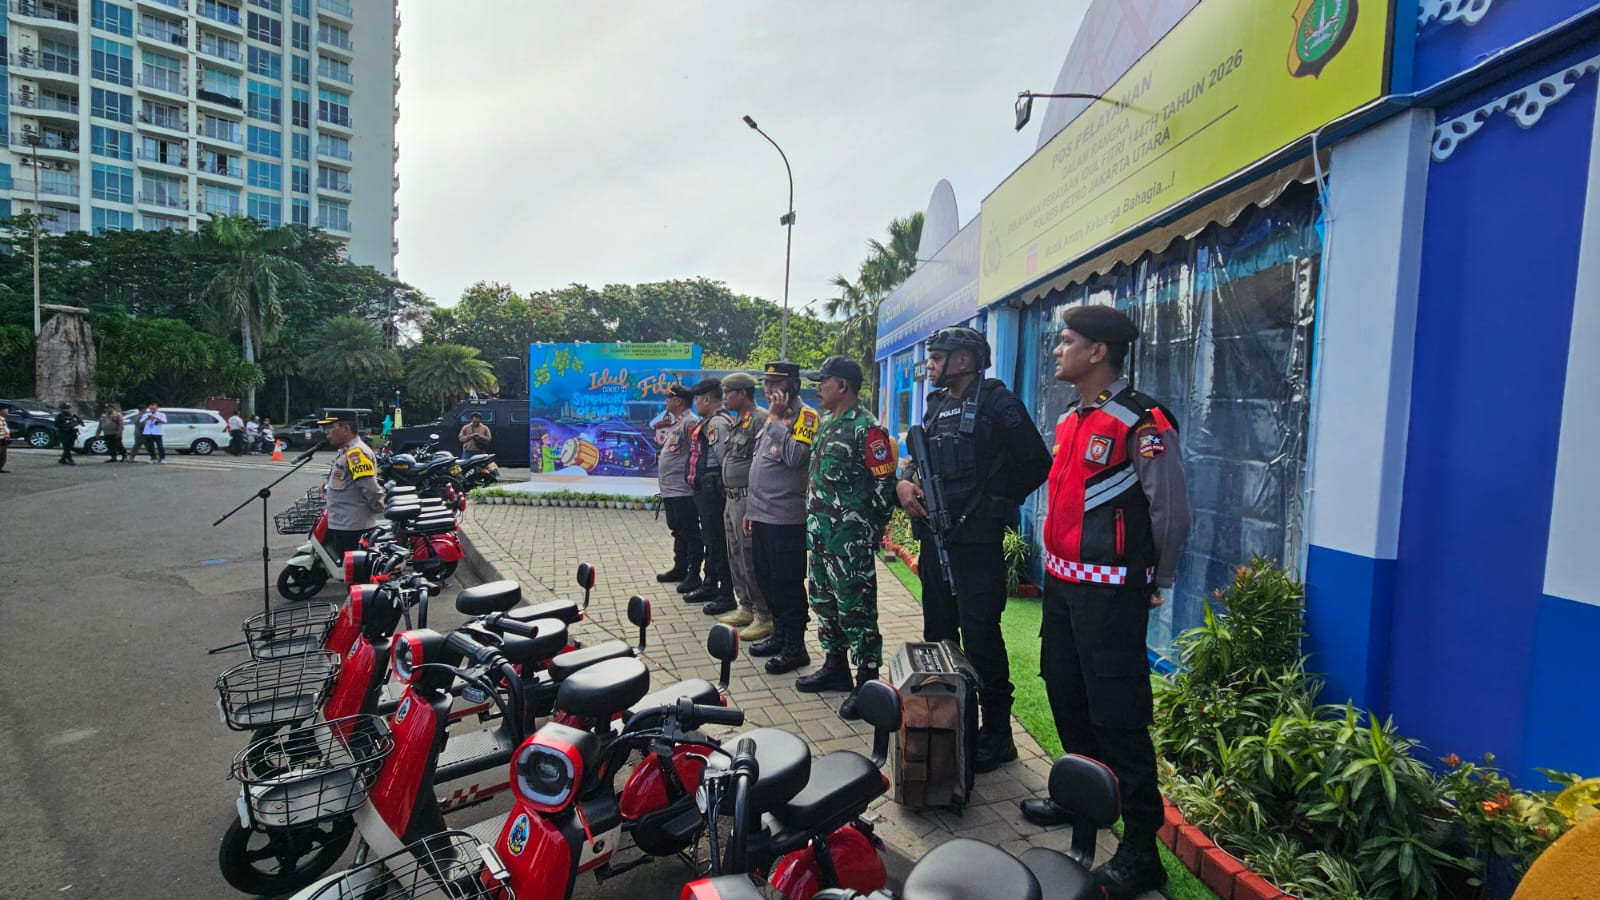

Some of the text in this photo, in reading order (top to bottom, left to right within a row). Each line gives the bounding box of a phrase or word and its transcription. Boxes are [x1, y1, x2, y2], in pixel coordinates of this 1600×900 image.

[1052, 71, 1152, 169] POS PELAYANAN
[1078, 162, 1100, 186] IDUL
[1101, 141, 1125, 168] FITRI
[1161, 75, 1206, 122] TAHUN
[1208, 47, 1244, 89] 2026
[1063, 116, 1130, 179] DALAM RANGKA
[1032, 125, 1171, 232] POLRES METRO JAKARTA UTARA
[573, 391, 627, 406] SYMPHONY
[588, 367, 629, 391] Idul
[576, 405, 627, 417] OF THE SEA
[938, 407, 961, 419] POLISI
